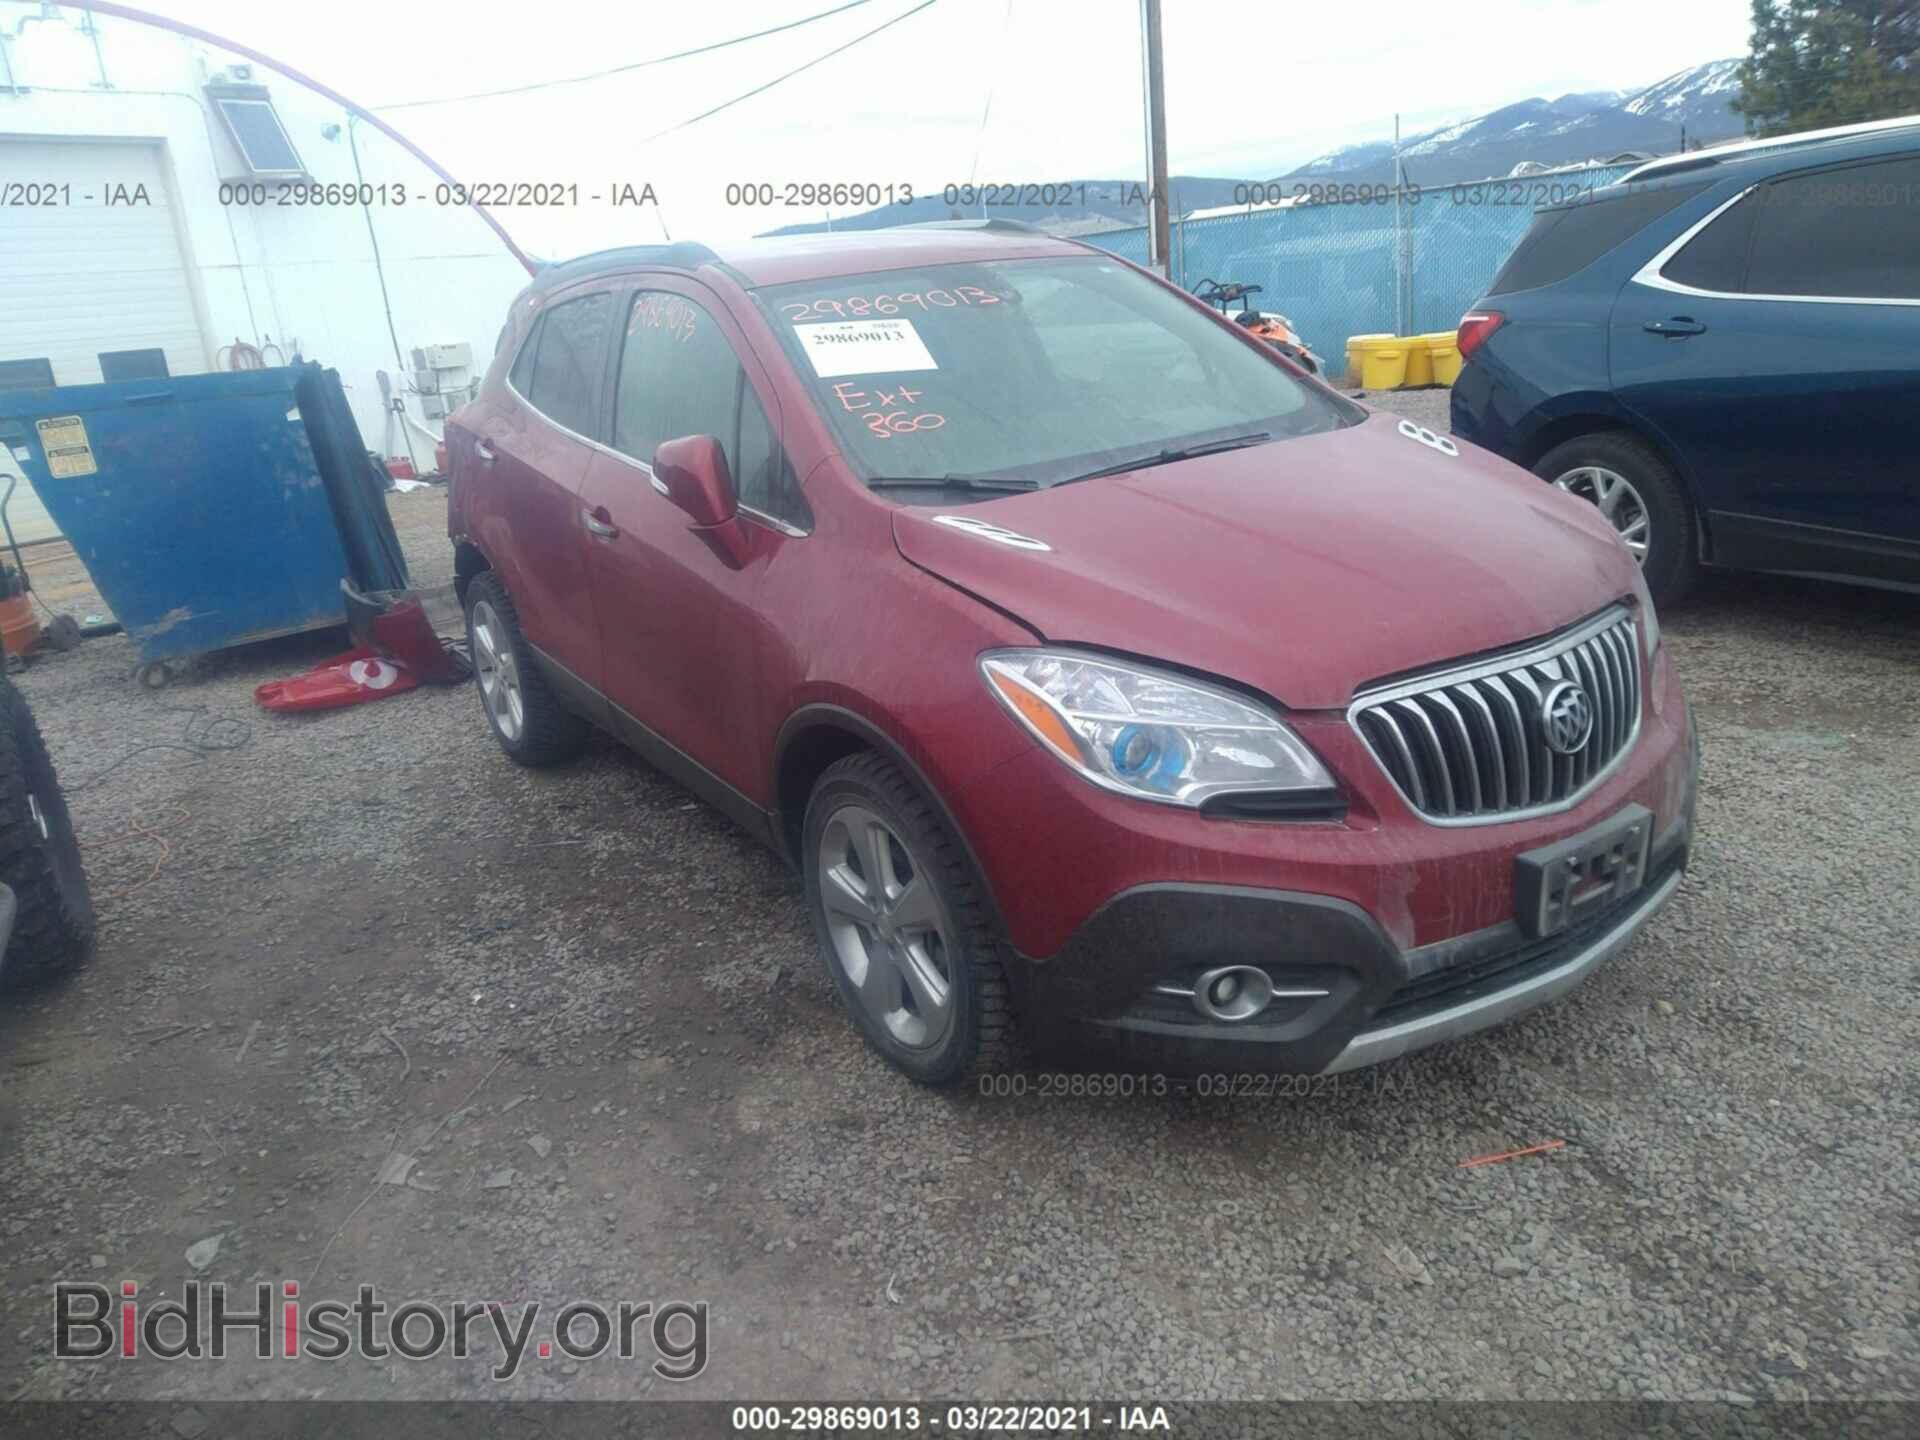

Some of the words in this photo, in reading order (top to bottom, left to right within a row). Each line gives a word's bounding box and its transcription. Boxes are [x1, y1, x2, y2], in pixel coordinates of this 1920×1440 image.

[781, 286, 1000, 321] 29869013
[813, 331, 904, 345] 29869013
[832, 382, 922, 412] Ext
[862, 411, 945, 438] 360
